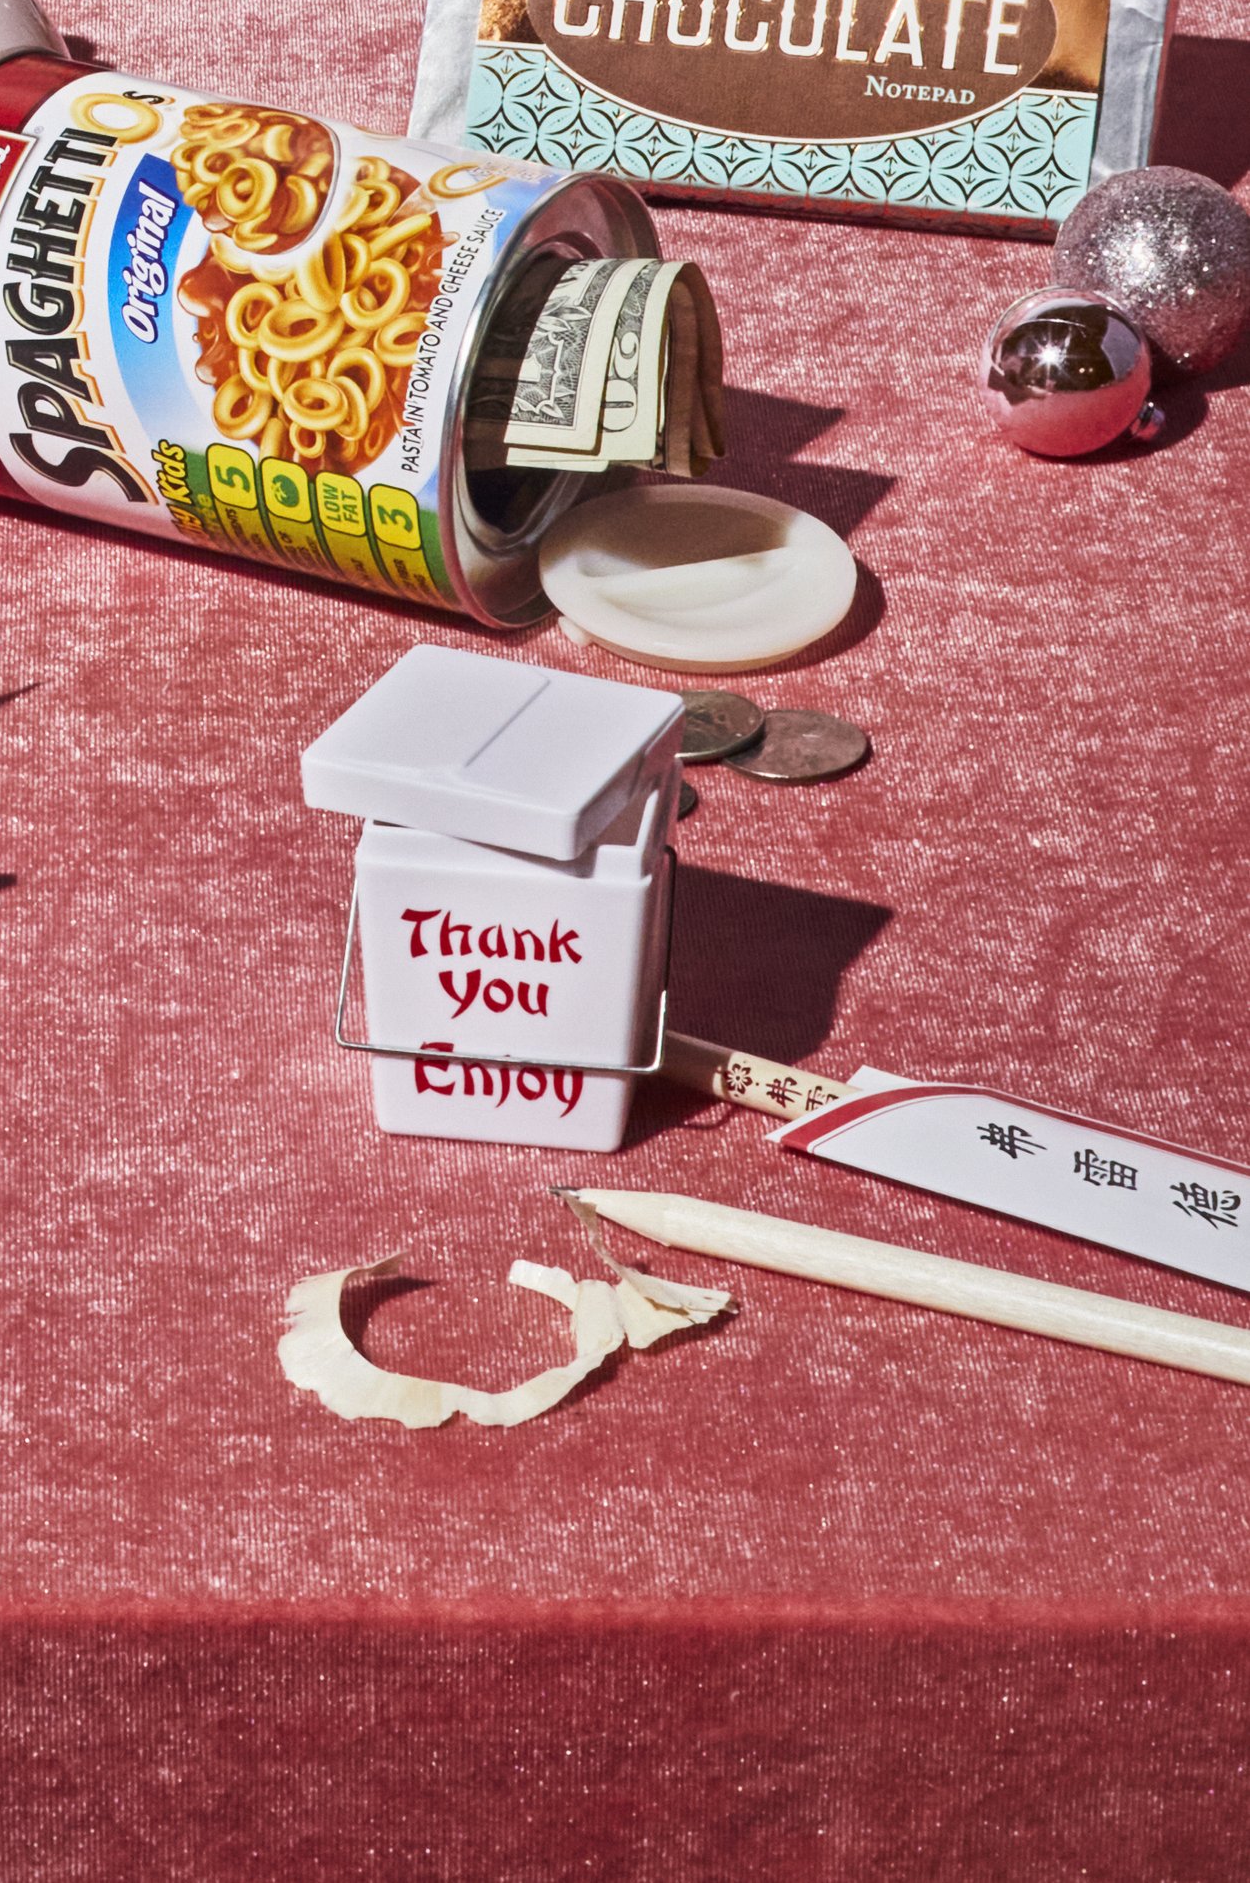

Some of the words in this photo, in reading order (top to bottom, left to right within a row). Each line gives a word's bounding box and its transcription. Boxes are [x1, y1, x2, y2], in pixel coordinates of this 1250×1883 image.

[466, 208, 504, 250] SAUCE
[121, 178, 178, 344] Original
[441, 244, 479, 296] CHEESE
[432, 293, 454, 332] AND
[409, 329, 442, 402] TOMATO
[405, 402, 424, 425] IN
[151, 439, 194, 506] Kids
[401, 428, 422, 474] PASTA
[214, 465, 250, 493] 5
[322, 482, 340, 523] LOW
[341, 493, 359, 525] FAT
[377, 504, 414, 532] 3
[400, 908, 582, 964] Thank
[438, 969, 549, 1019] You
[415, 1041, 583, 1119] Enjoy
